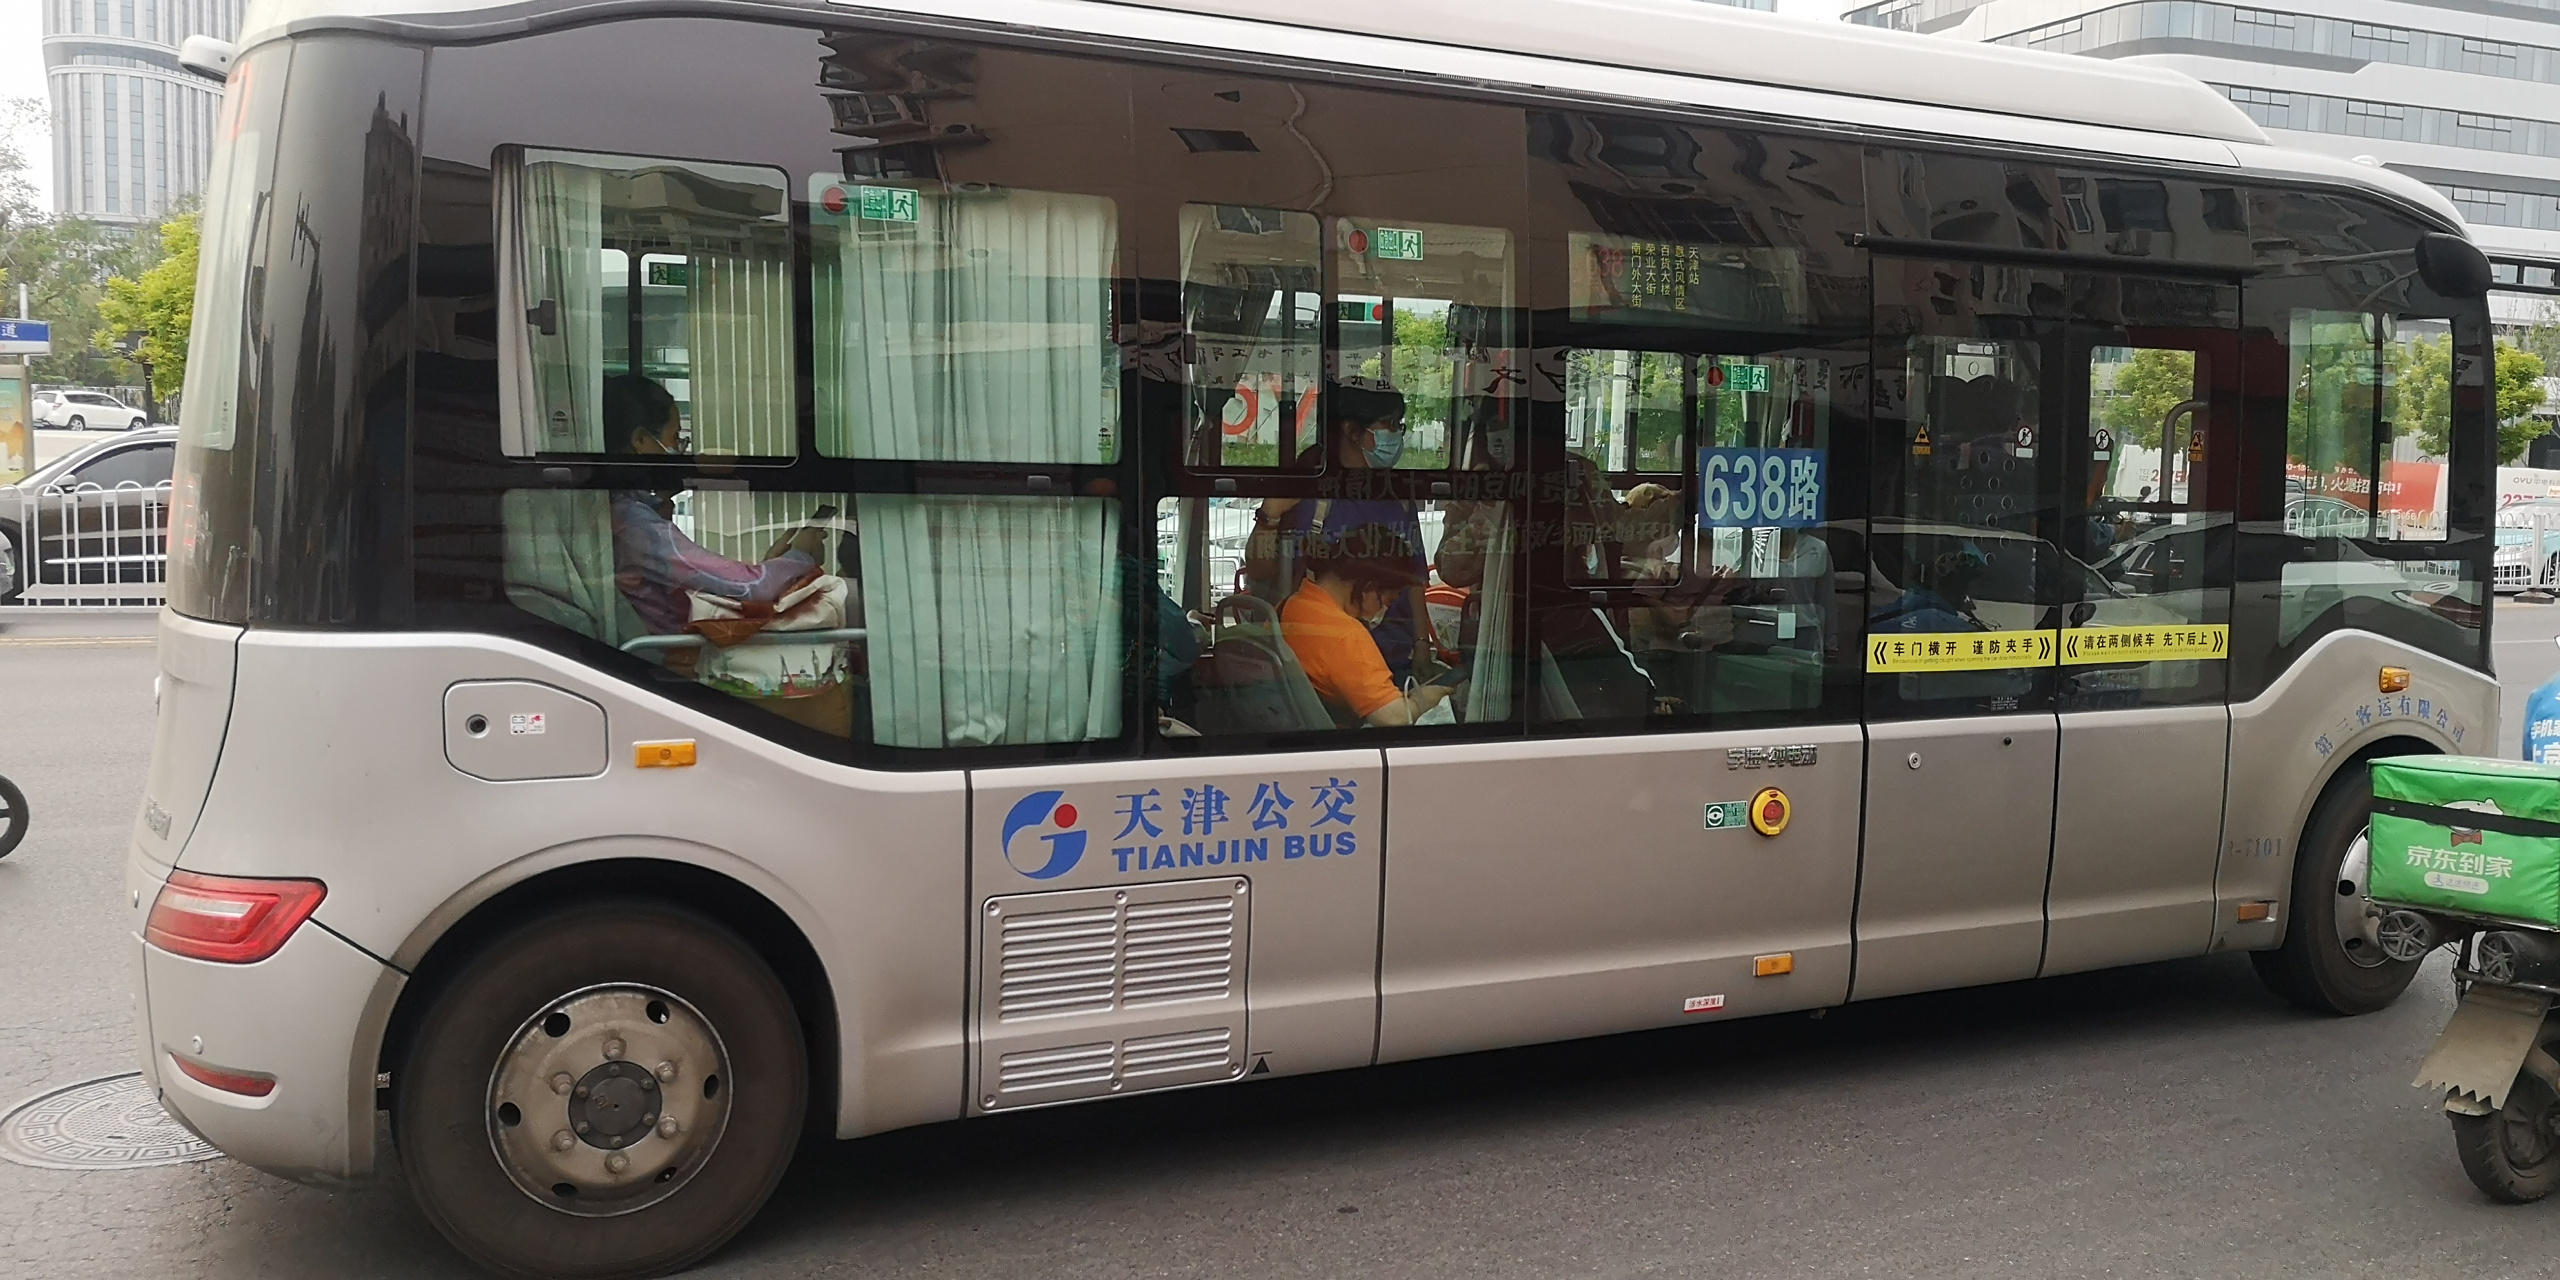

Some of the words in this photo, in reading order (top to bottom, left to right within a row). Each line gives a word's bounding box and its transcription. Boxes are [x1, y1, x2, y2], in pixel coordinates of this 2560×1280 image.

[1631, 242, 1642, 308] 南门外大街
[1646, 243, 1656, 296] 荣业大街
[1661, 244, 1671, 297] 百货大楼
[1689, 246, 1700, 285] 天津站
[1, 323, 18, 338] 道
[1704, 454, 1820, 520] 638路
[2513, 477, 2533, 485] OVU
[1893, 641, 1957, 656] 车门横开
[1973, 638, 2033, 655] 谨防夹手
[2084, 633, 2154, 649] 请在两侧候车
[2163, 632, 2207, 646] 先下后上
[2315, 695, 2465, 758] 第三客运有限公司
[1113, 777, 1358, 841] 天津公交
[1111, 838, 1268, 872] TIANJIN
[1284, 831, 1357, 860] BUS
[2406, 845, 2513, 878] 京东到家
